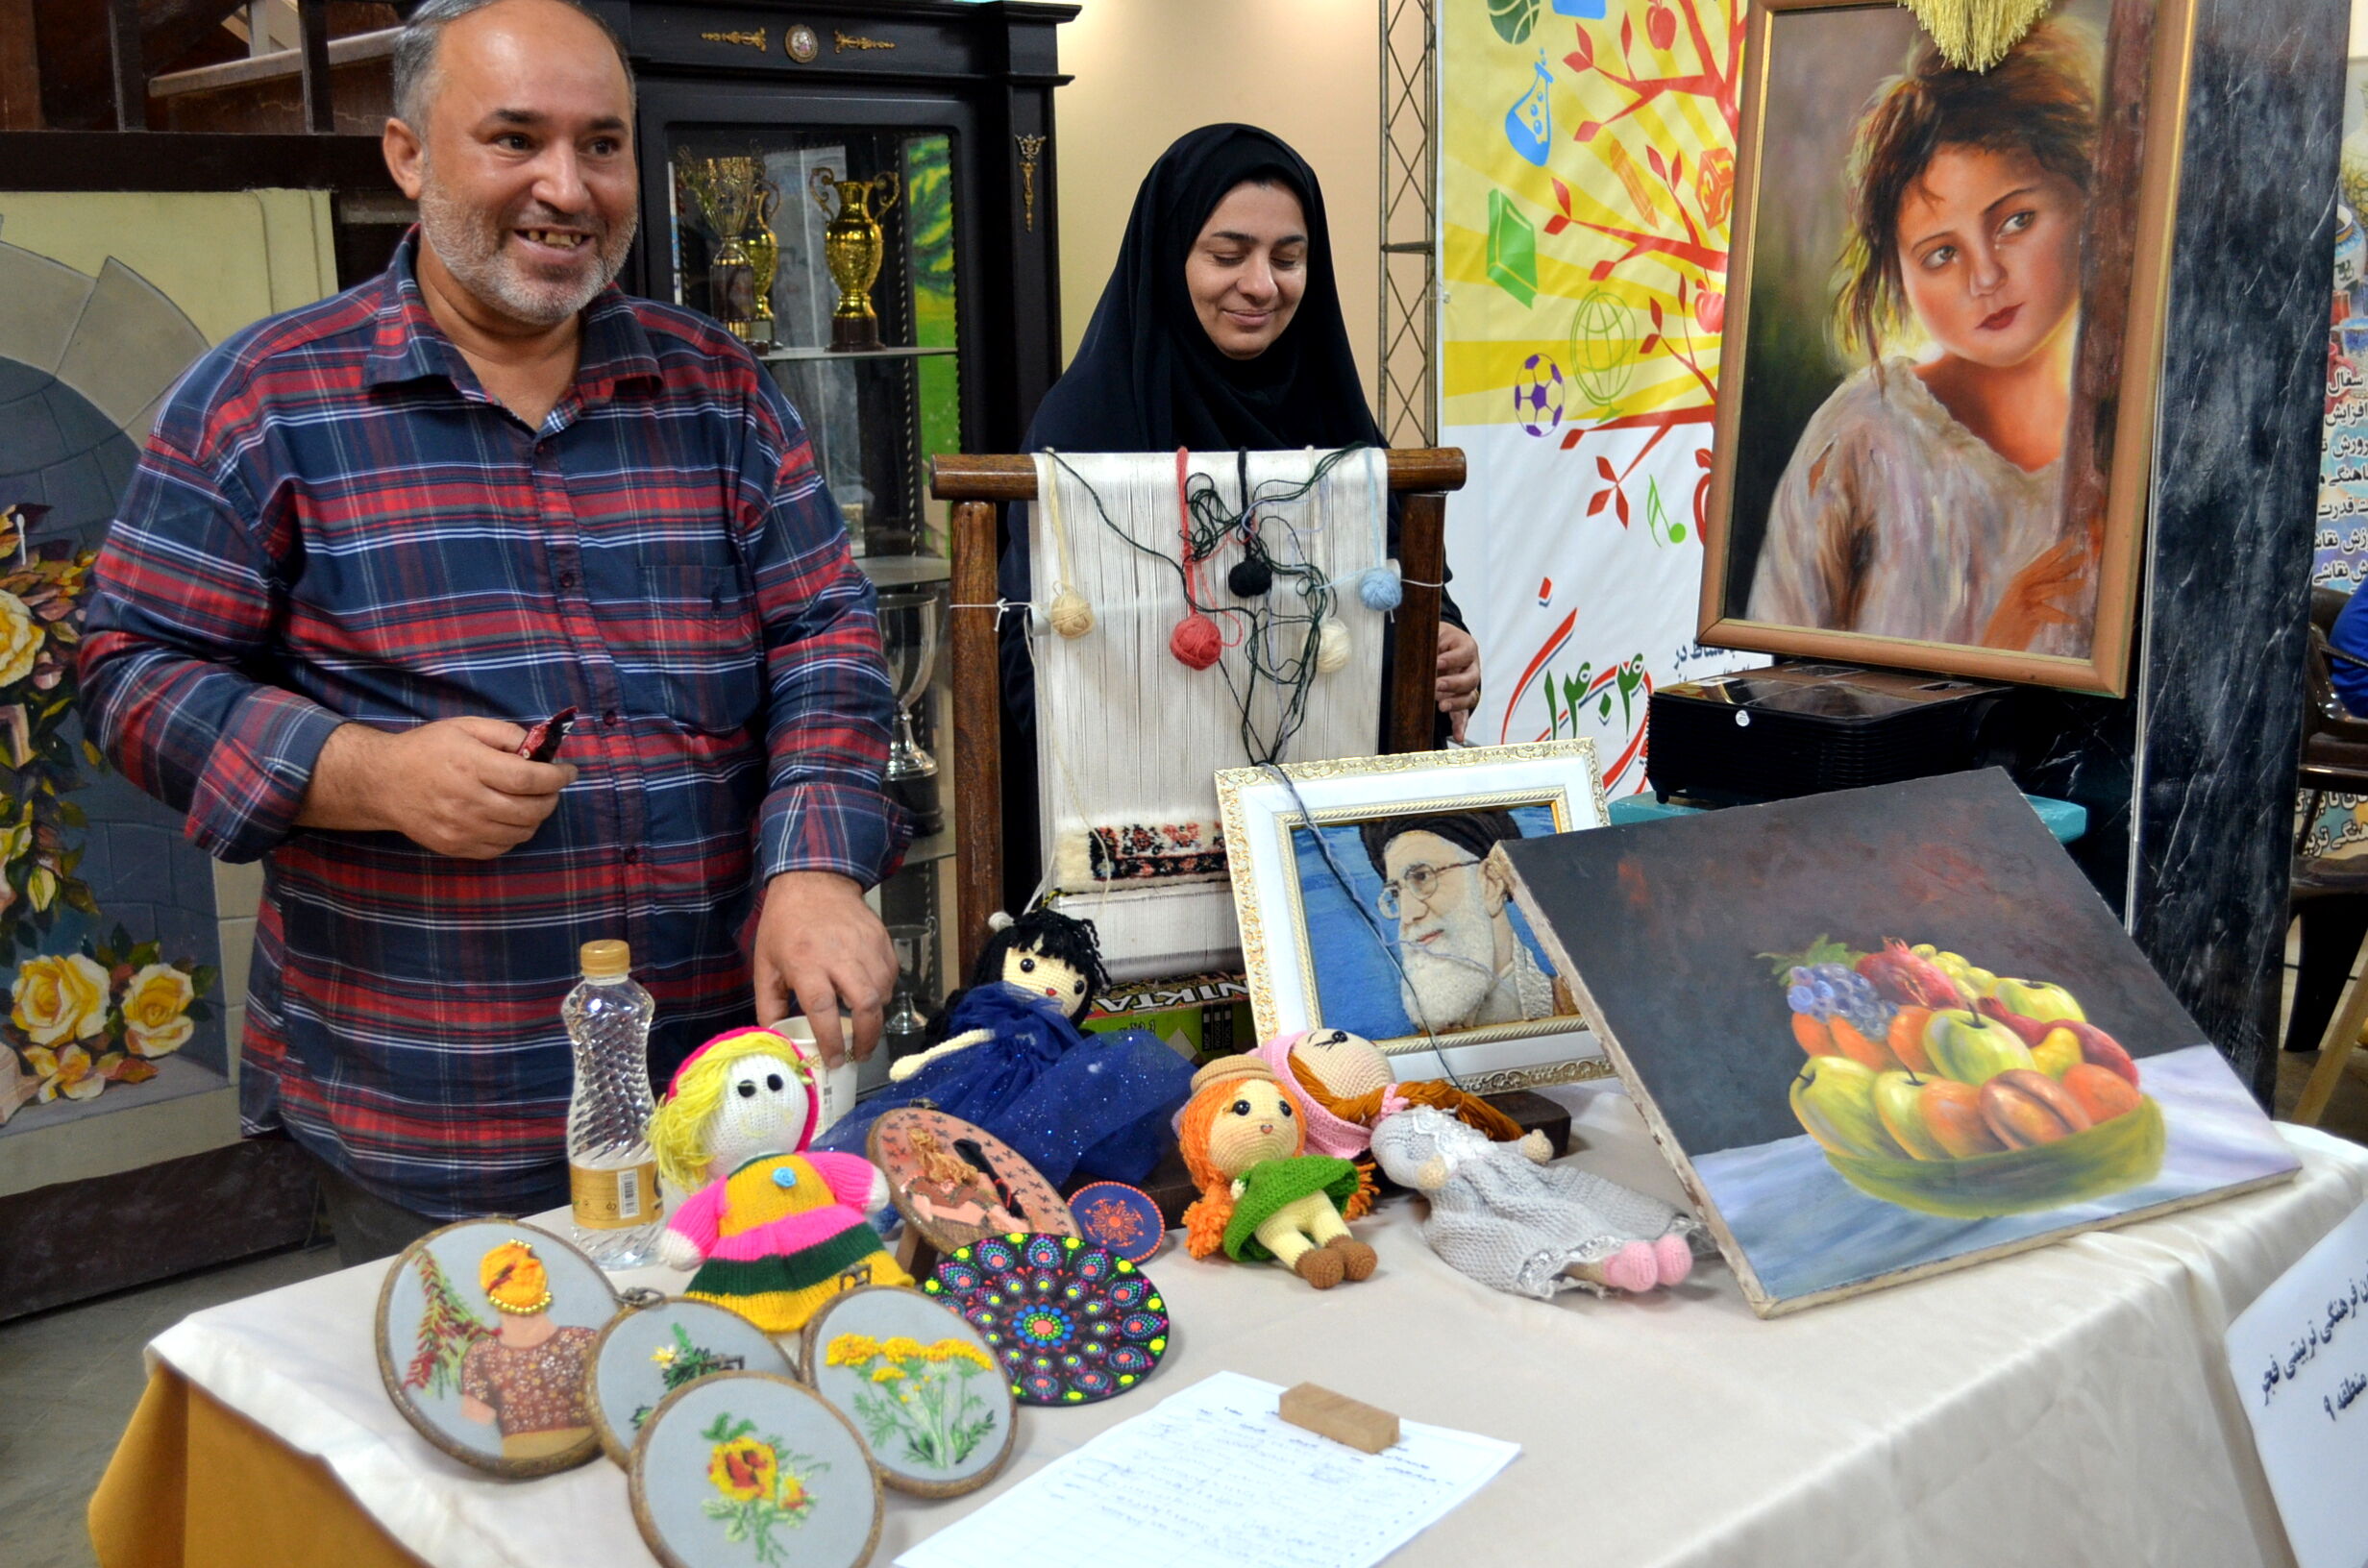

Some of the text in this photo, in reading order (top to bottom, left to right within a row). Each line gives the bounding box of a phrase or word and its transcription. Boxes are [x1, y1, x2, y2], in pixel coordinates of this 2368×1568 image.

[2328, 371, 2363, 394] سفال
[2317, 496, 2355, 520] قدرت
[2313, 562, 2349, 584] نقاشی
[2261, 1279, 2357, 1407] فرهنگی تربیتی فجر
